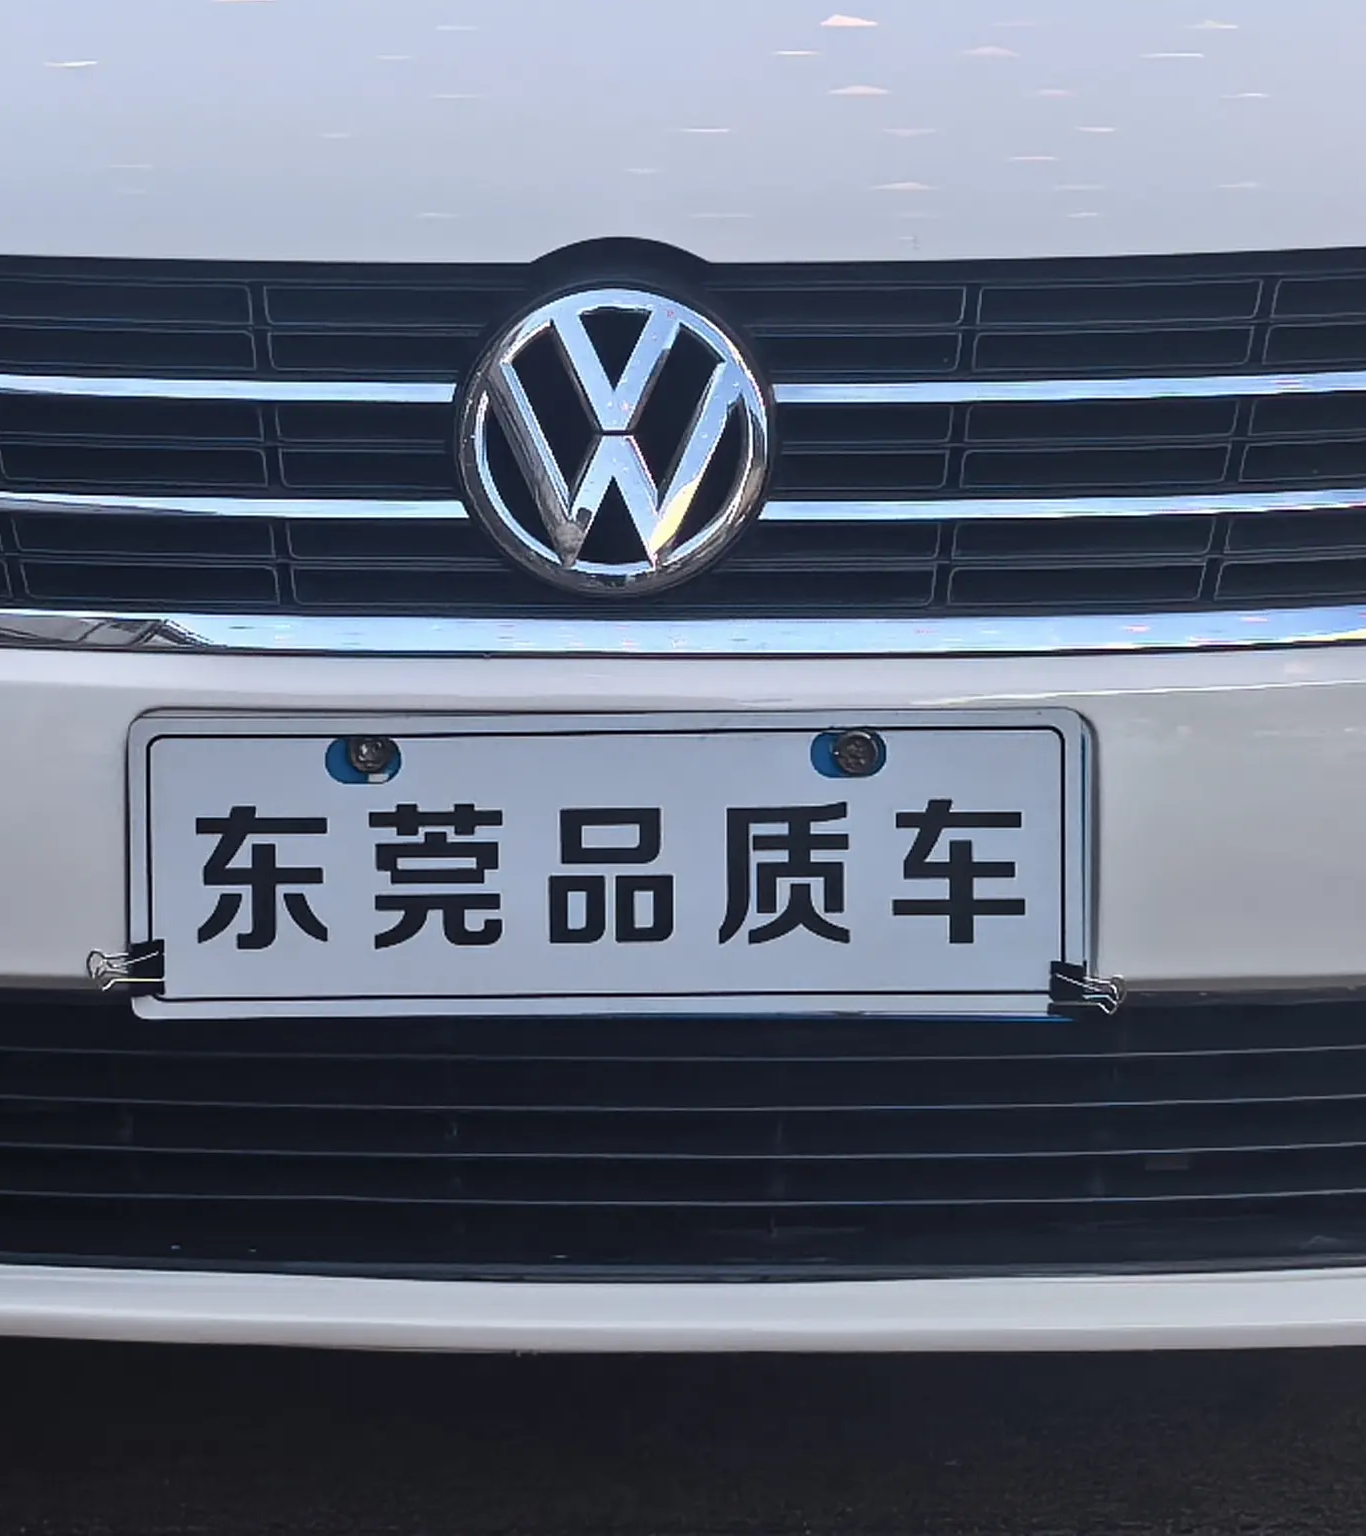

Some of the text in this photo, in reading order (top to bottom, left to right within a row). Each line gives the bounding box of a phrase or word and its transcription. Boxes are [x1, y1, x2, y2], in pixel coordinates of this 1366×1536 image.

[475, 288, 767, 586] VW
[194, 798, 1026, 951] 东莞品质车
